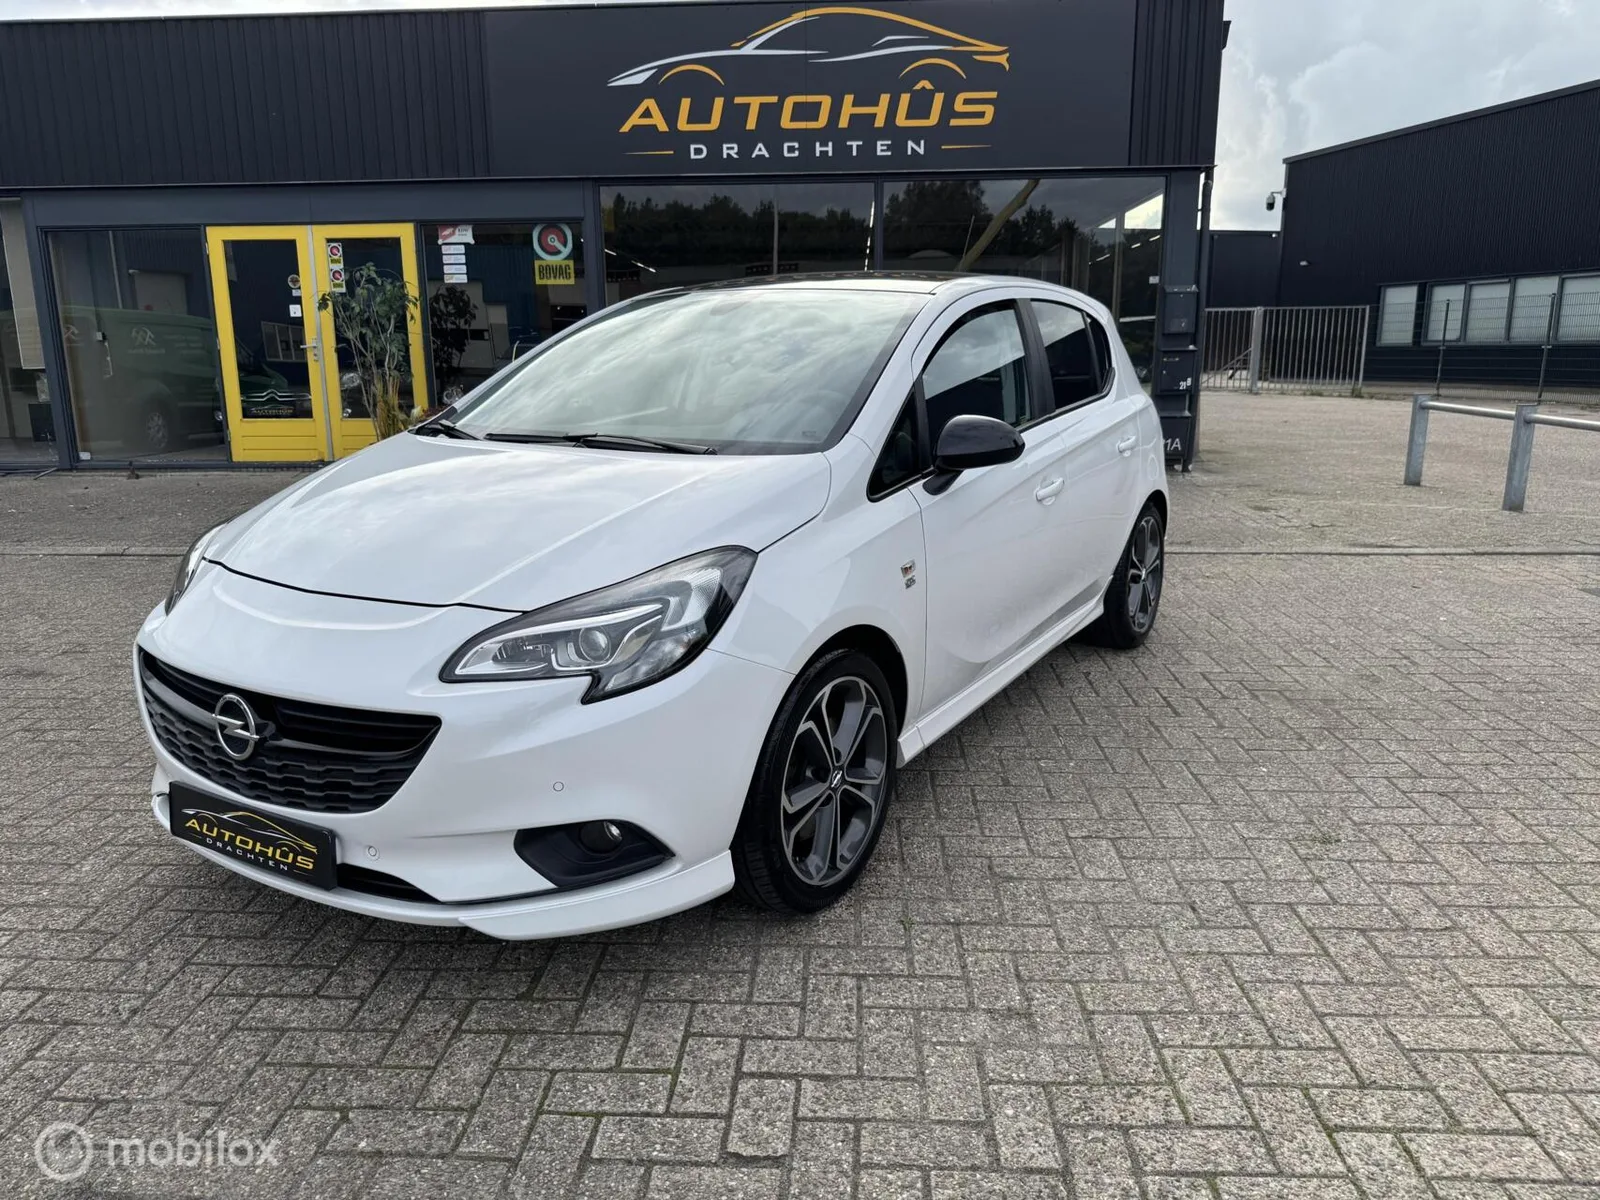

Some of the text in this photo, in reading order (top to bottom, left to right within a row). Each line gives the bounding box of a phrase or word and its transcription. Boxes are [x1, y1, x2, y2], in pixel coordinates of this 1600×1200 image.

[618, 79, 998, 133] AUTOHÛS
[690, 139, 925, 160] DRACHTEN
[538, 263, 572, 281] BOVAG
[1162, 438, 1182, 451] 1A
[185, 818, 315, 870] AUTOHÛS
[206, 837, 288, 871] DRACHTEN
